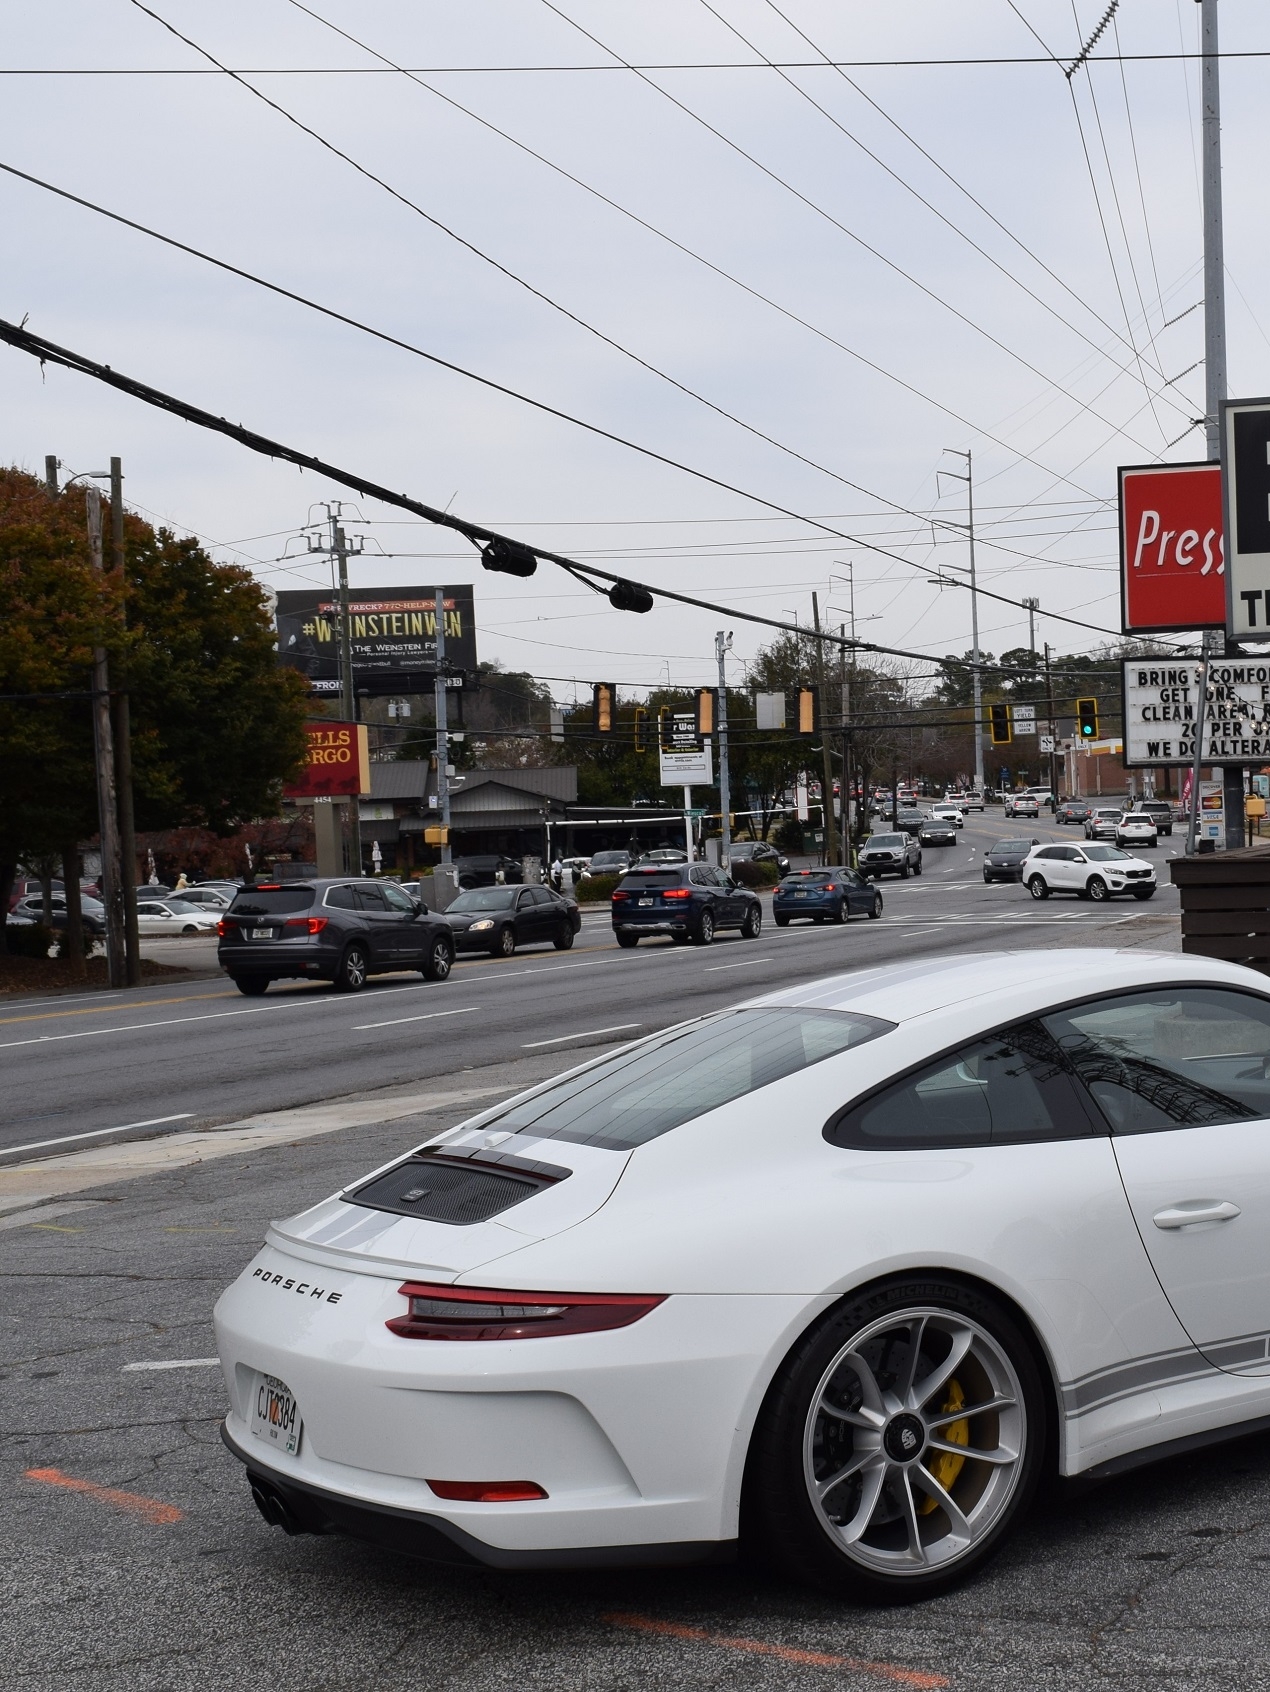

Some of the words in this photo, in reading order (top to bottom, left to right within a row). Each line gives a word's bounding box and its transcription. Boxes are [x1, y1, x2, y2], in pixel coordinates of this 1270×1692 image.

[384, 600, 451, 610] 770-HELP-NW
[376, 643, 422, 651] WEINSTEIN
[1138, 669, 1188, 686] BRING
[1160, 687, 1190, 703] GET
[1141, 704, 1193, 721] CLEAN
[1206, 704, 1250, 719] AREA
[1211, 722, 1243, 737] PER
[308, 730, 350, 747] ELLS
[1147, 741, 1171, 757] WE
[252, 1268, 343, 1304] PORSCHE
[887, 1285, 958, 1300] MICHELIN
